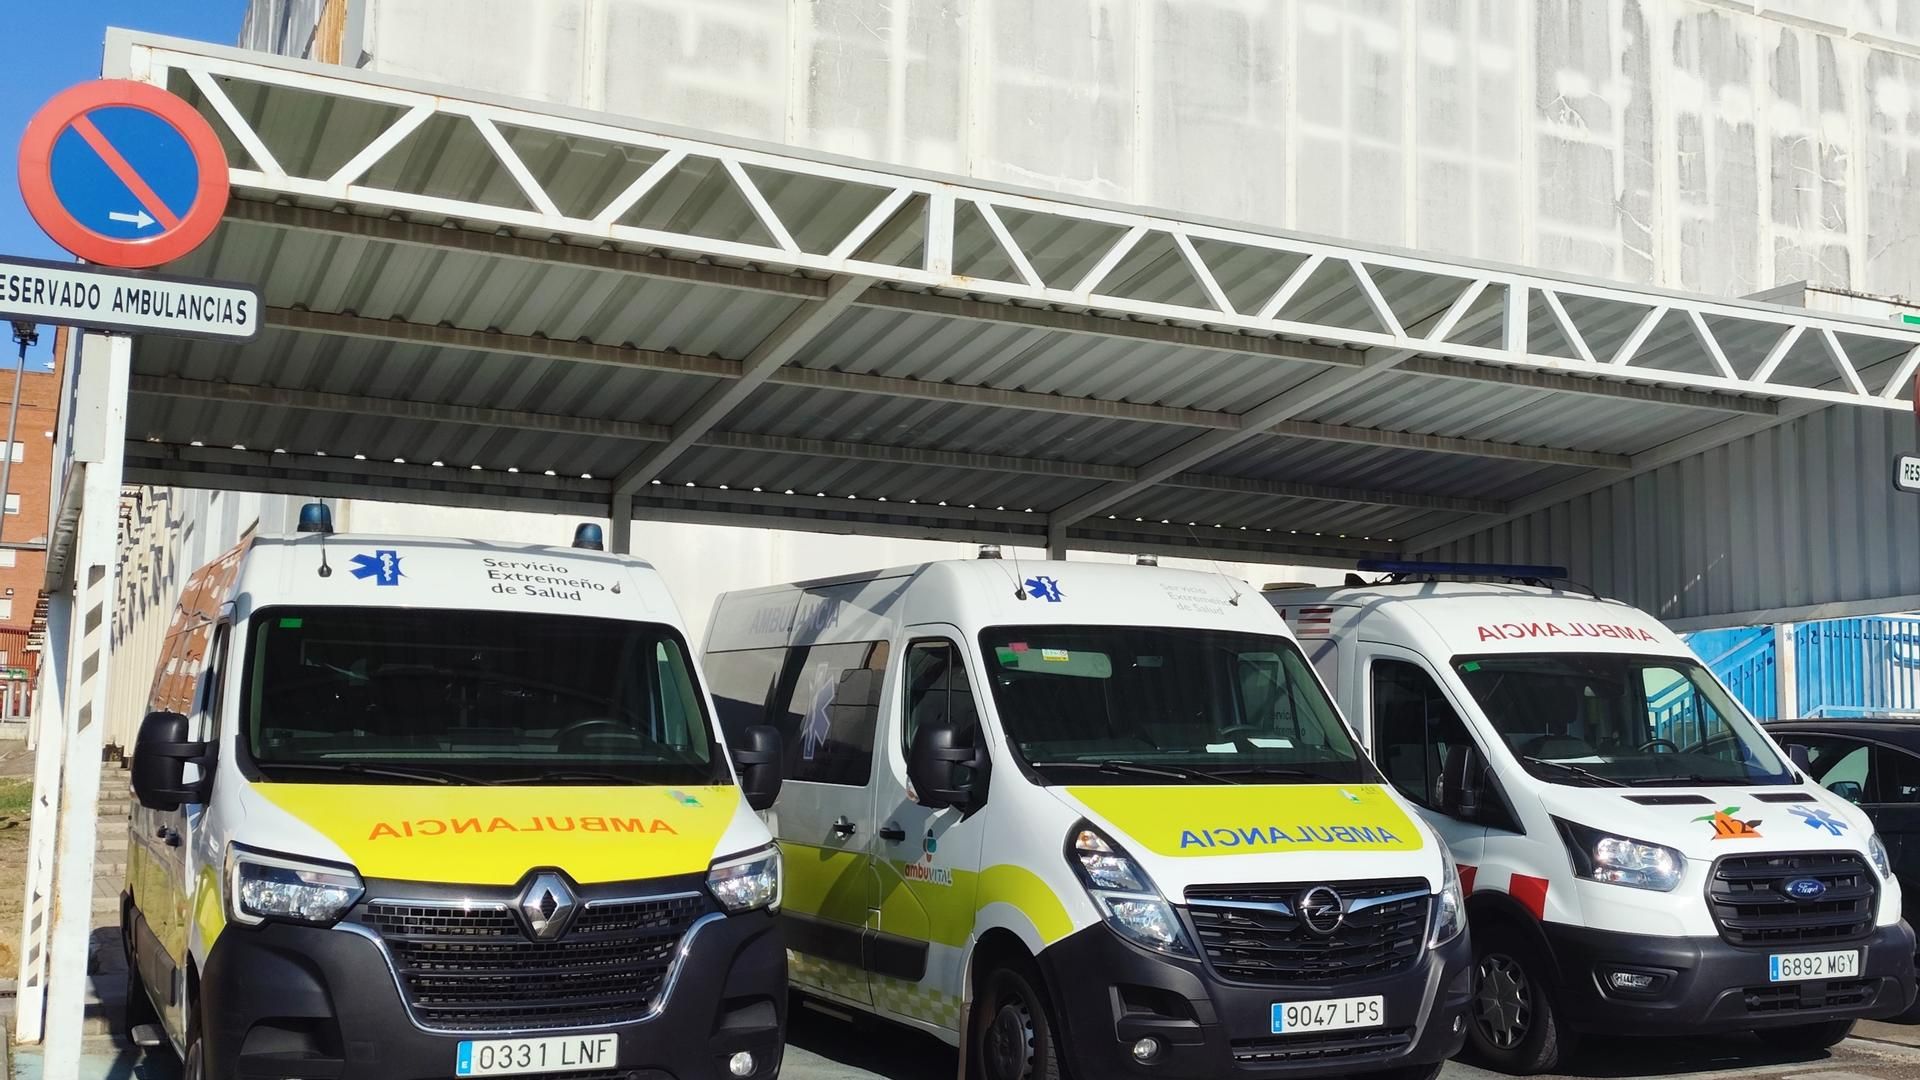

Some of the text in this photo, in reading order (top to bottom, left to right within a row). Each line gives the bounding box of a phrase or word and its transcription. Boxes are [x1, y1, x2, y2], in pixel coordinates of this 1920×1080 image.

[111, 286, 247, 326] AMBULANCIAS
[482, 558, 569, 574] Servicio
[487, 569, 605, 591] Extremeño
[491, 583, 582, 601] de Salud
[1708, 819, 1755, 835] 112
[904, 863, 952, 884] ambuVITAL
[1782, 953, 1855, 977] 6892 MGY
[1287, 1004, 1338, 1027] 9047
[1345, 1001, 1379, 1024] LPS
[479, 1042, 547, 1070] 0331
[561, 1039, 612, 1066] LNF
